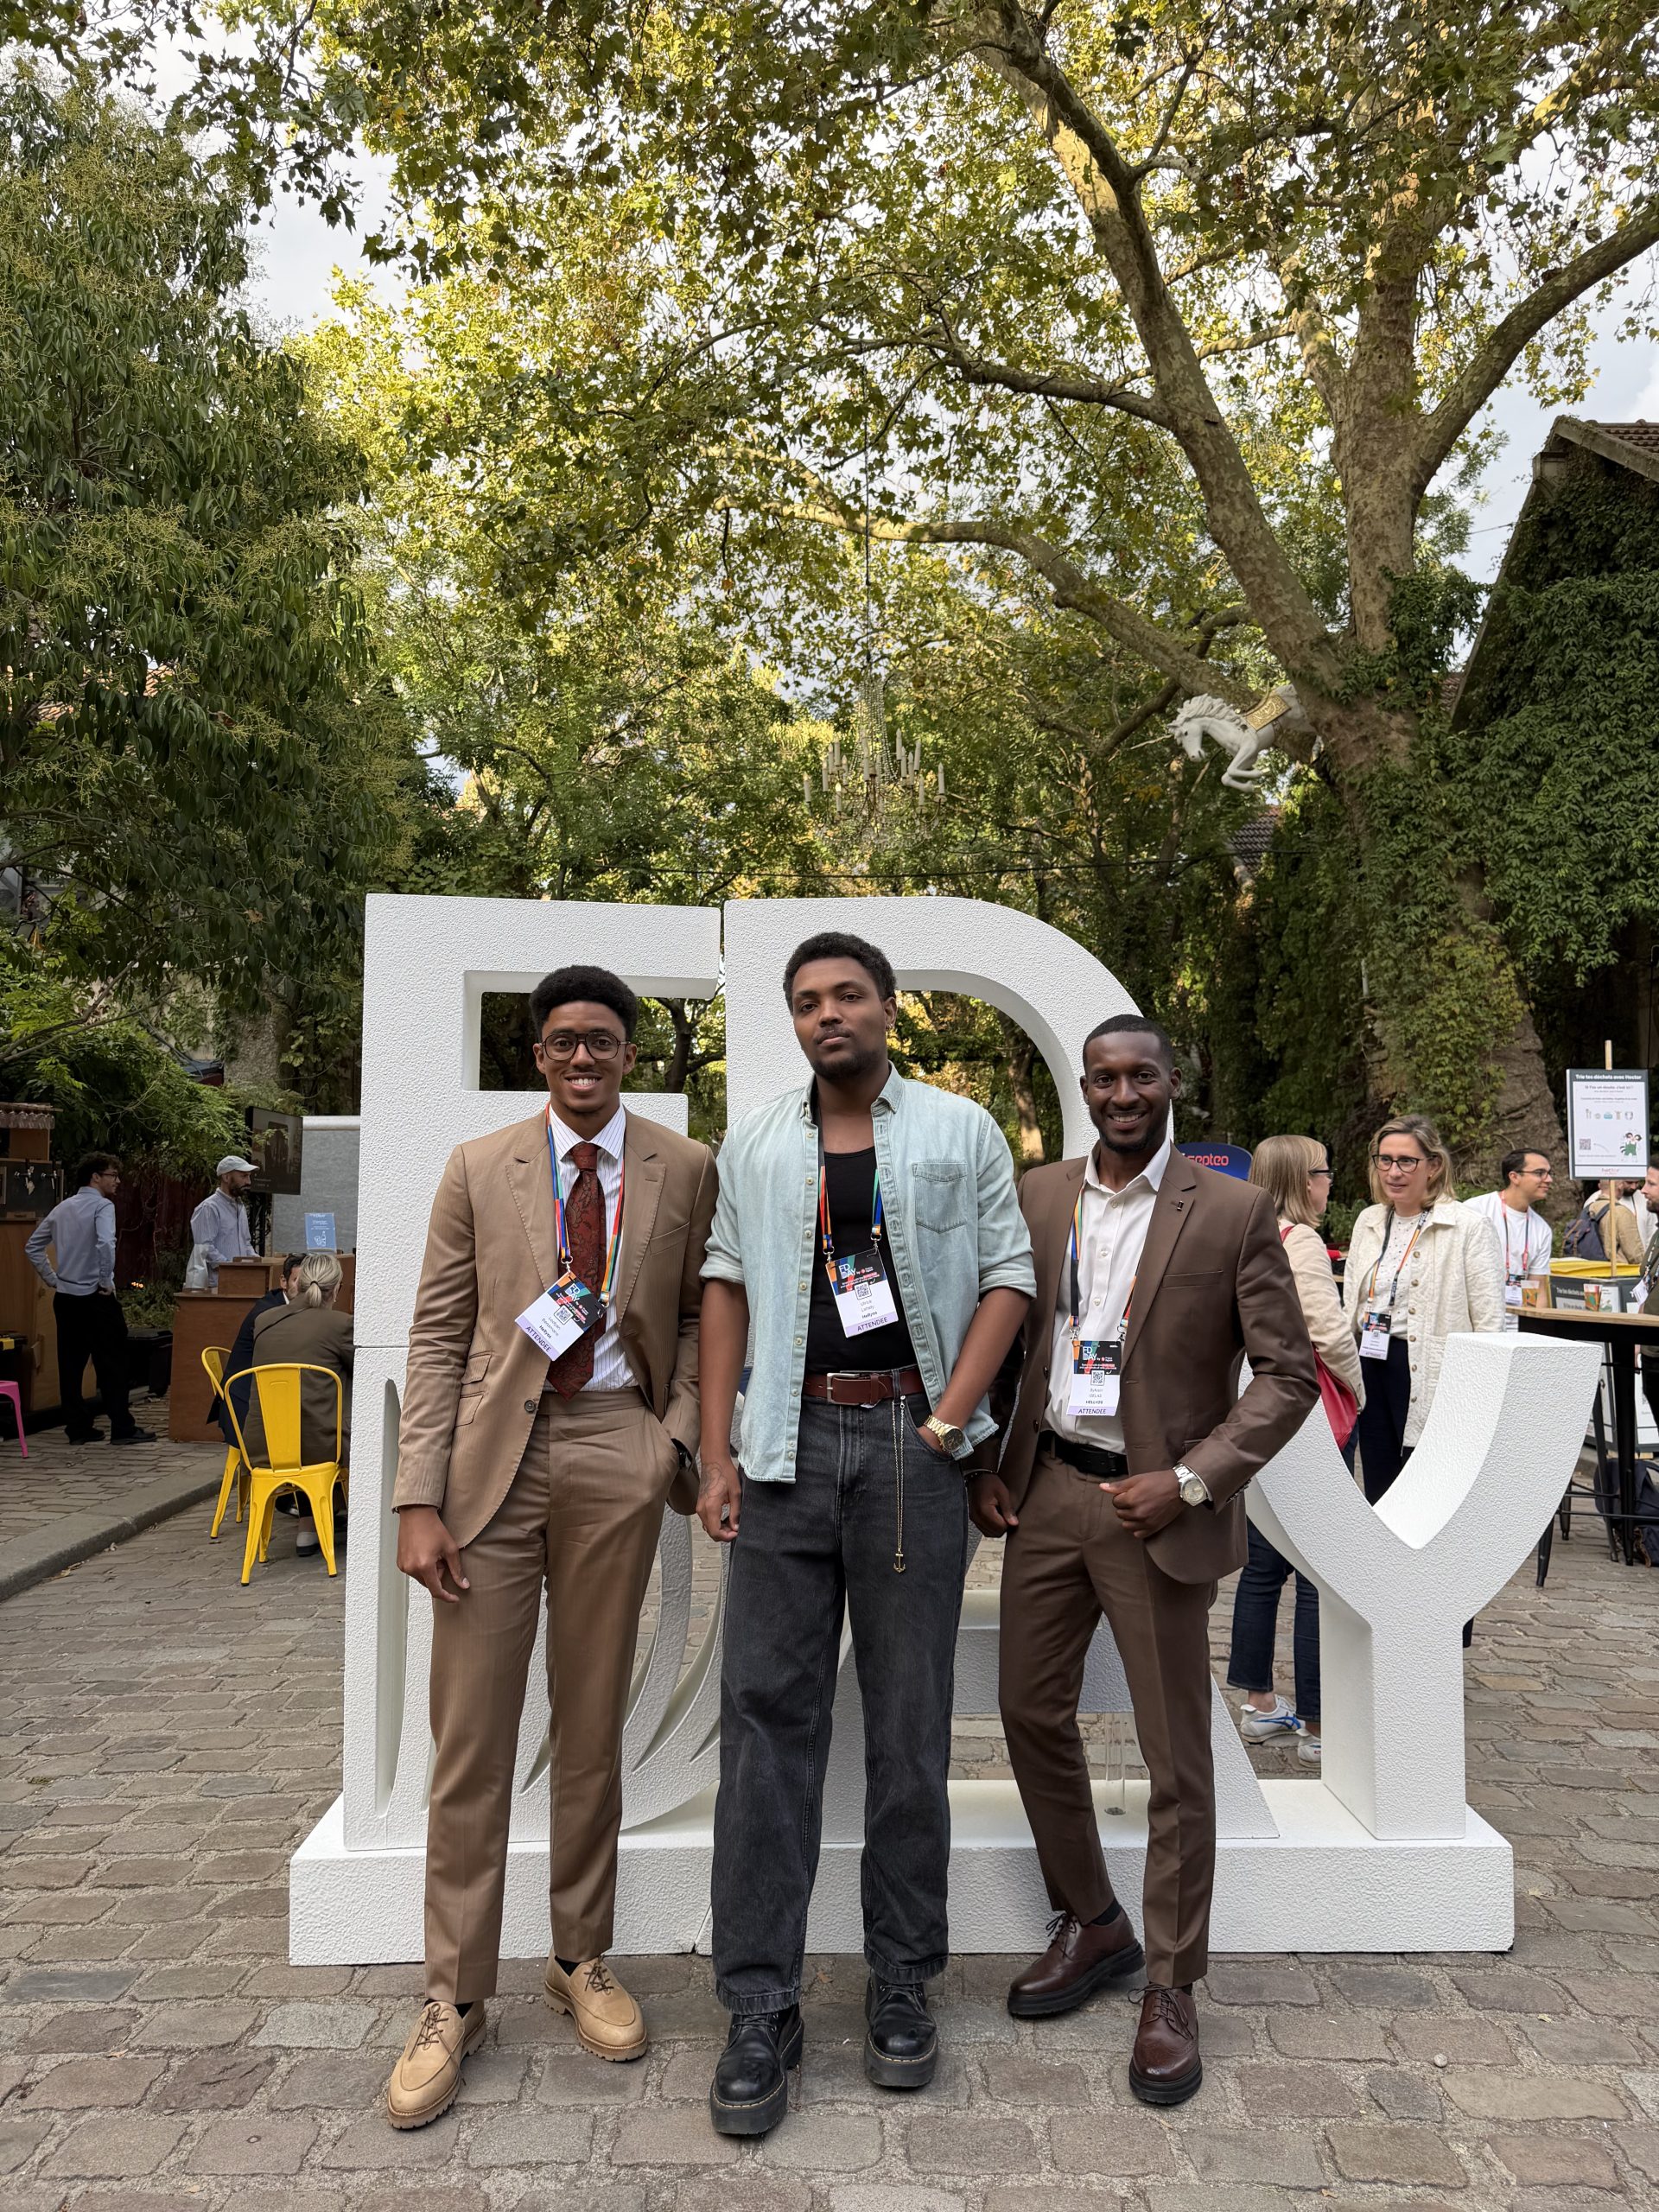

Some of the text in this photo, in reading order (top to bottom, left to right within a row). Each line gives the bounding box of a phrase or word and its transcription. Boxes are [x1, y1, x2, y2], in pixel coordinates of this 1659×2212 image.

[1188, 1154, 1229, 1166] epteo
[857, 1317, 888, 1332] ATTENDEE
[525, 1325, 552, 1353] ATTENDEE
